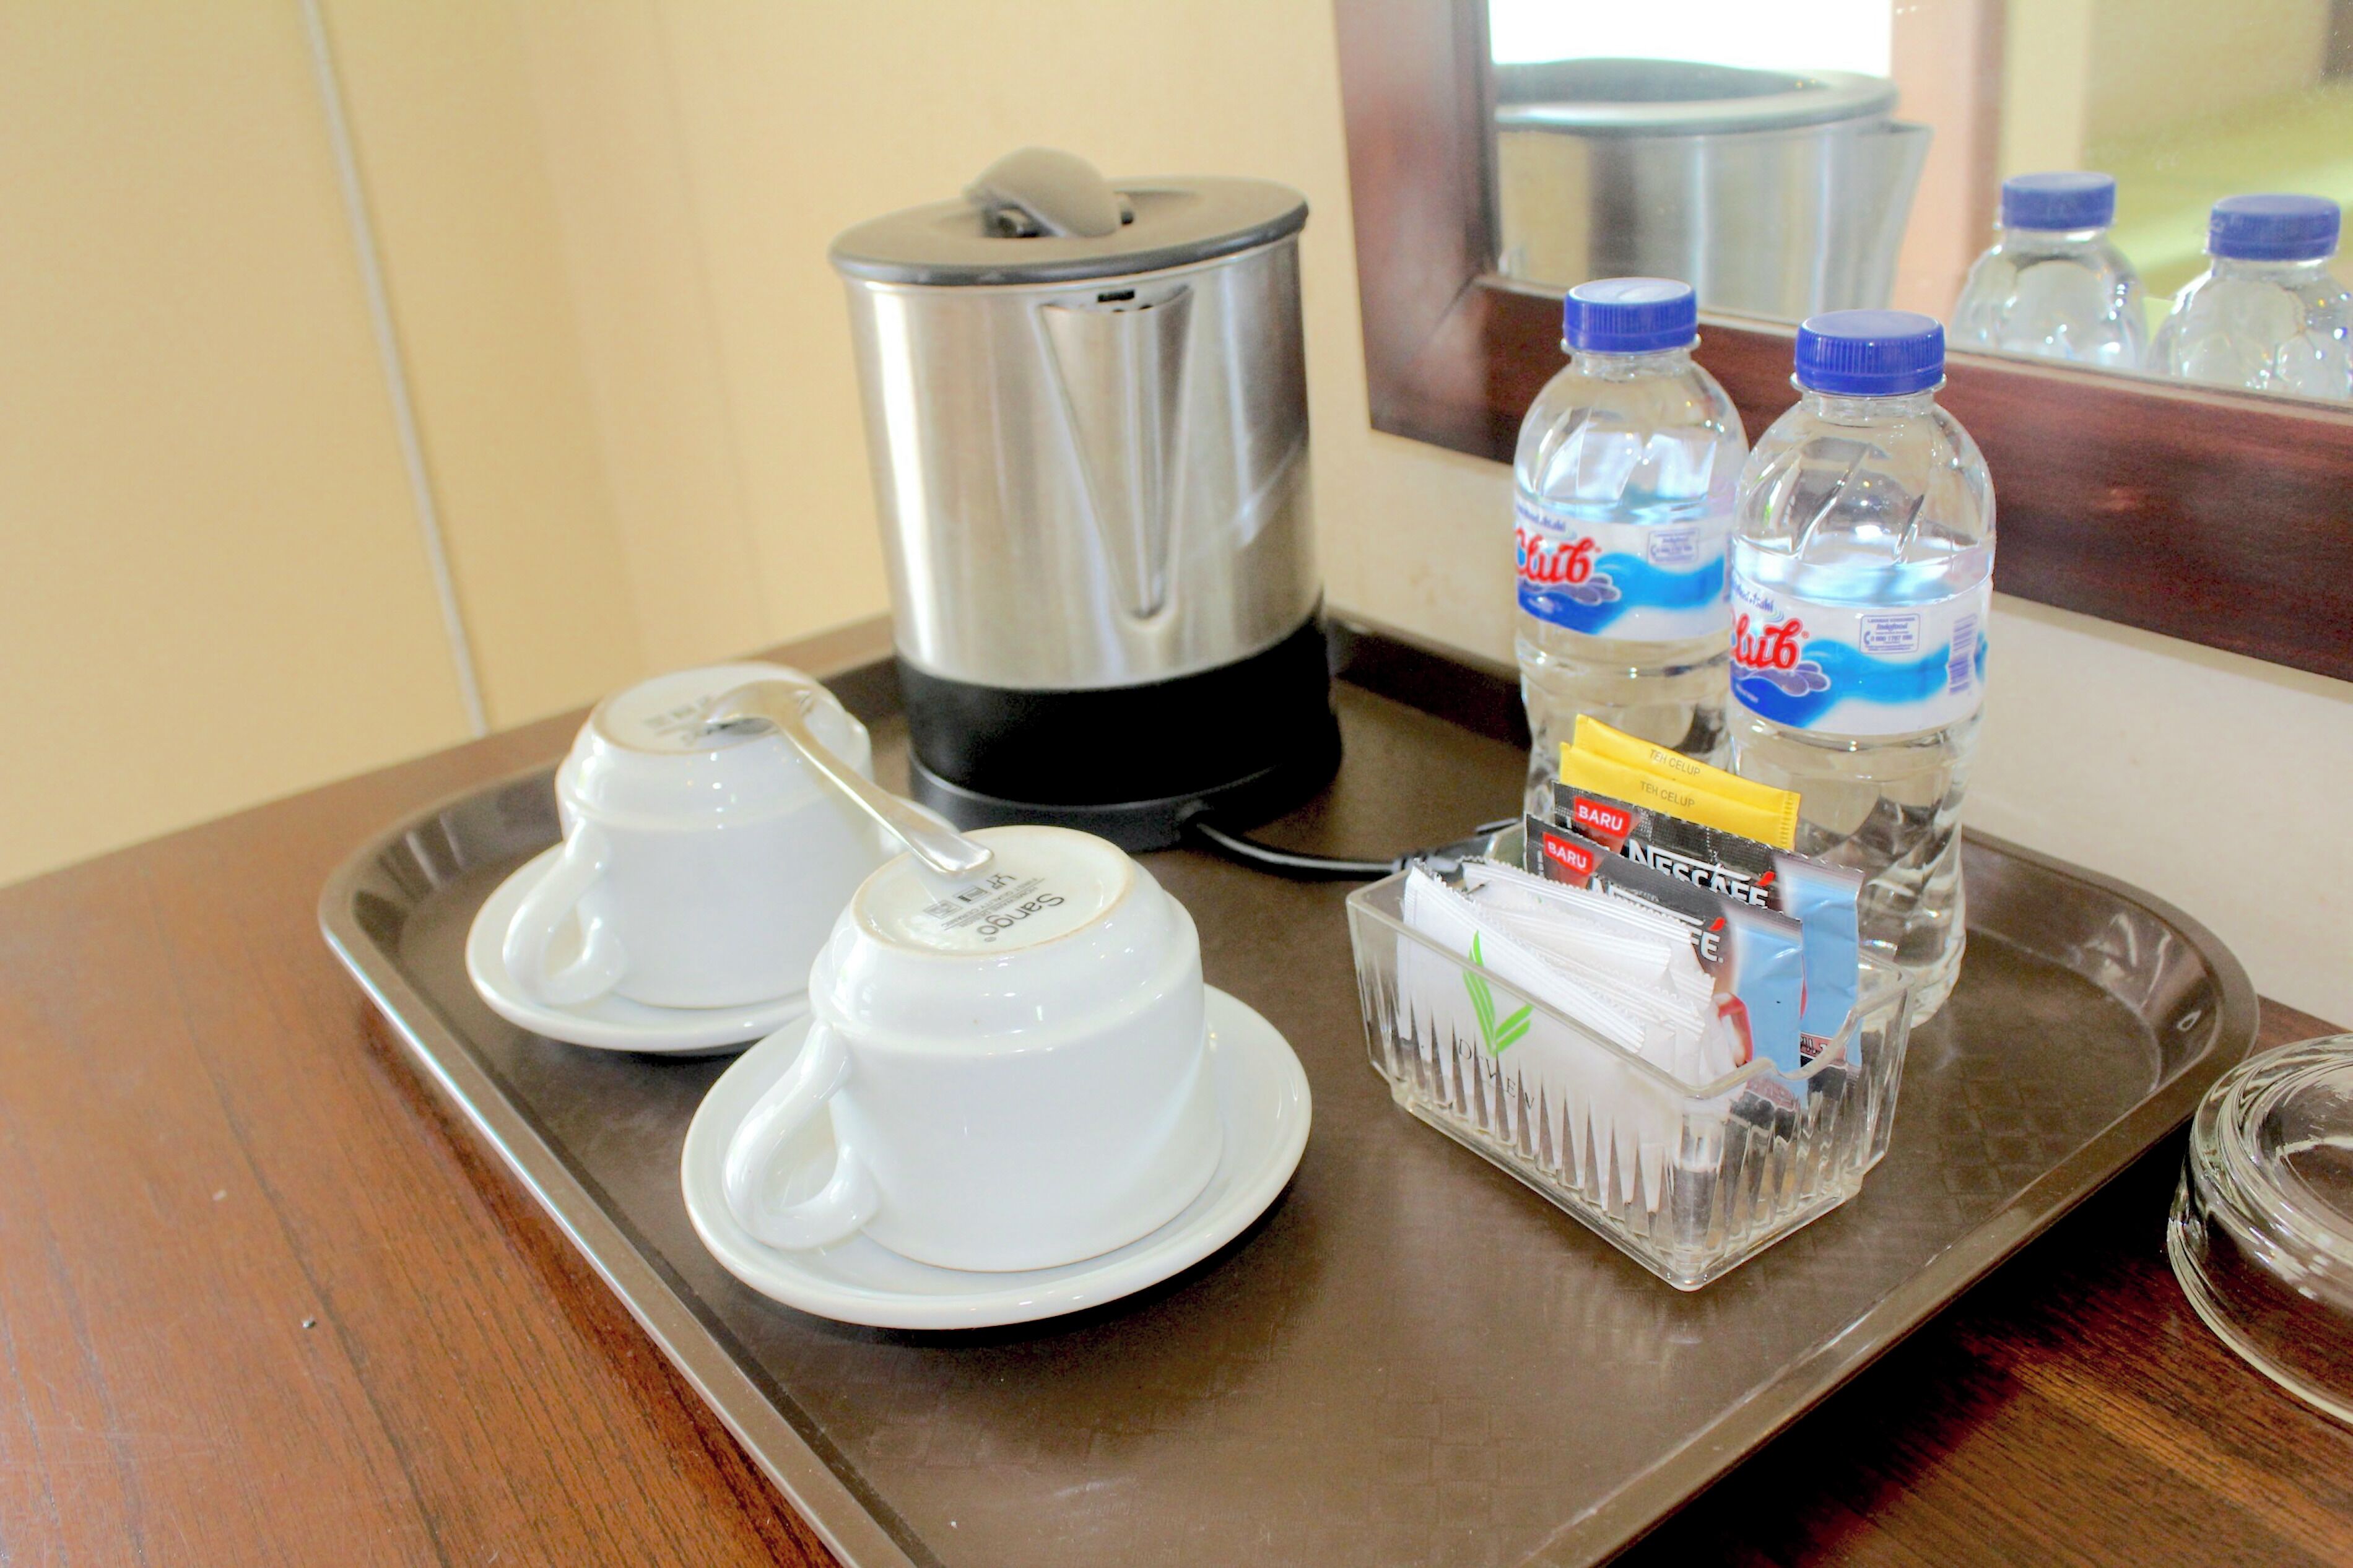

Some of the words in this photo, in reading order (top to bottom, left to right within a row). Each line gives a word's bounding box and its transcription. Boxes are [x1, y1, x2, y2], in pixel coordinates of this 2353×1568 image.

[1649, 748, 1668, 765] TEH
[1669, 757, 1701, 776] CELUP
[1640, 781, 1659, 797] TEH
[1661, 789, 1695, 808] CELUP
[1578, 805, 1624, 831] BARU
[1547, 841, 1588, 869] BARU
[976, 893, 1064, 935] Sango
